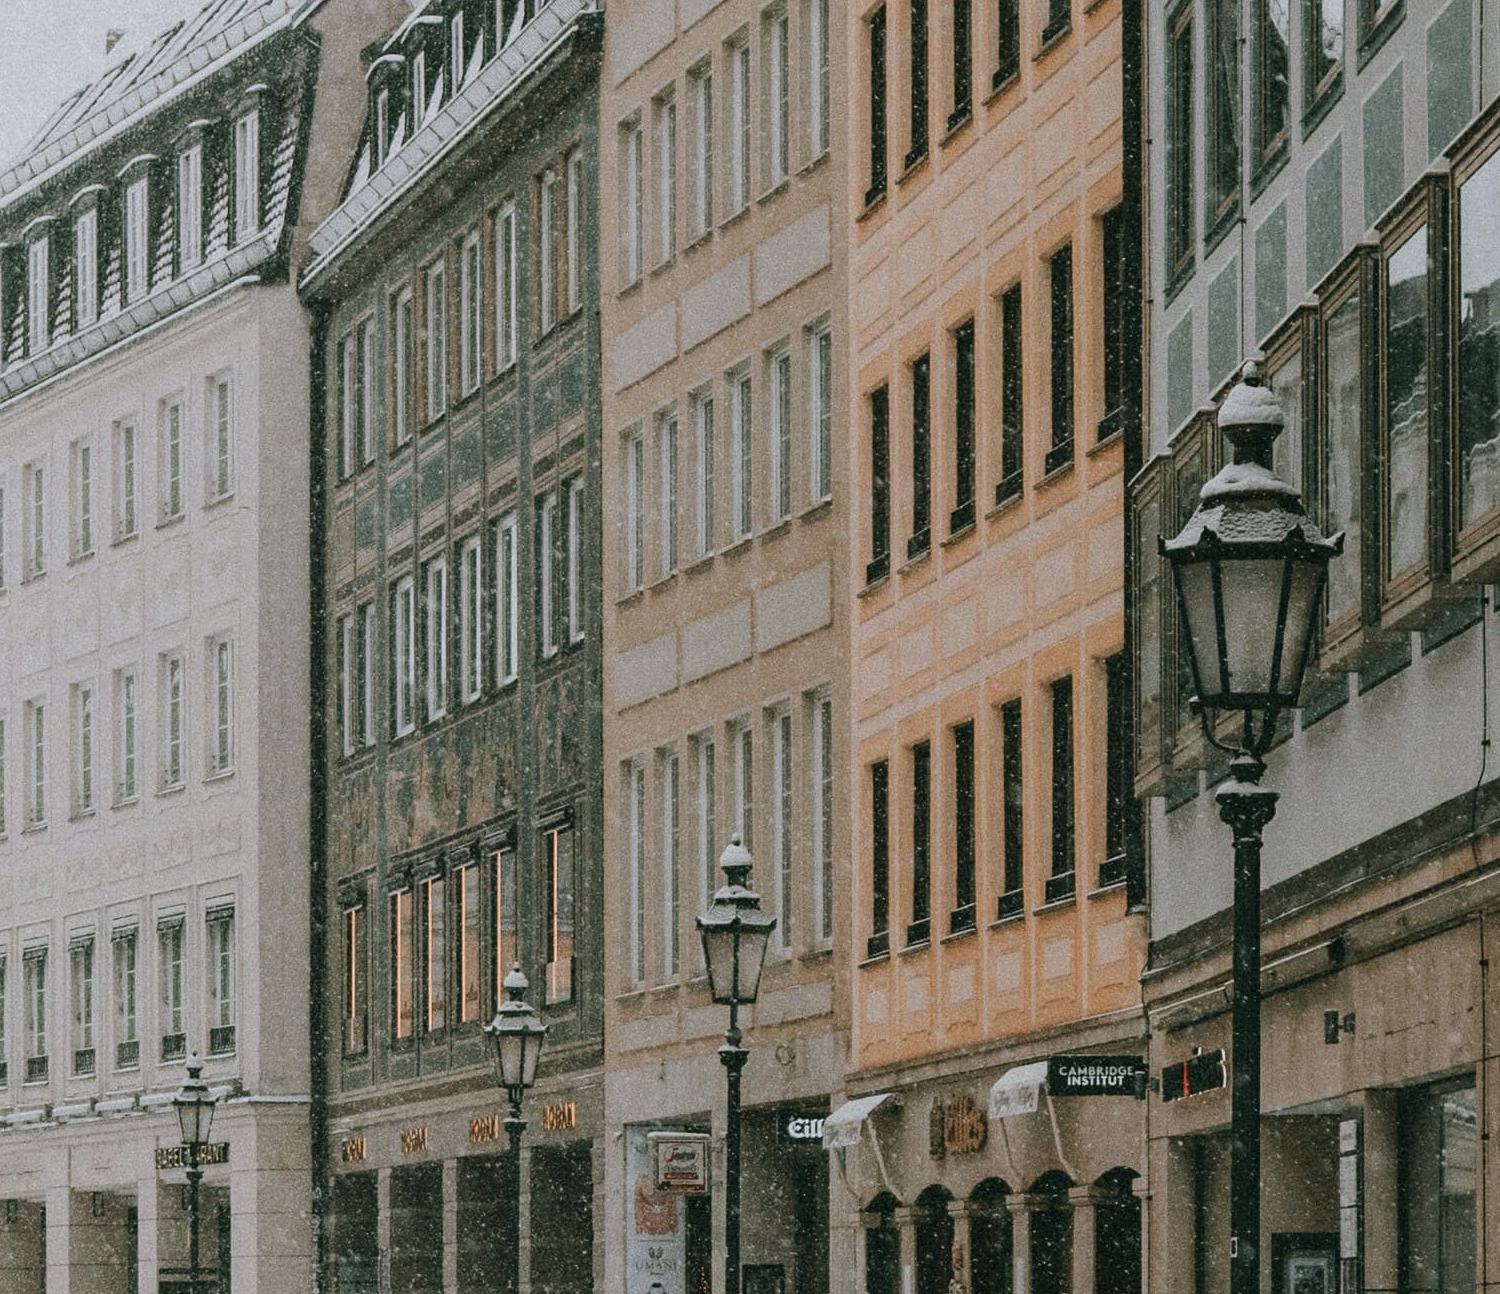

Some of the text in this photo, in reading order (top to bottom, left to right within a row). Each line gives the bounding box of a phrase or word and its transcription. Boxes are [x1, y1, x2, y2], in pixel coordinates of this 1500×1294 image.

[1059, 1066, 1134, 1076] CAMBRIDGE
[1067, 1076, 1124, 1086] INSTITUT
[787, 1118, 824, 1139] Eill
